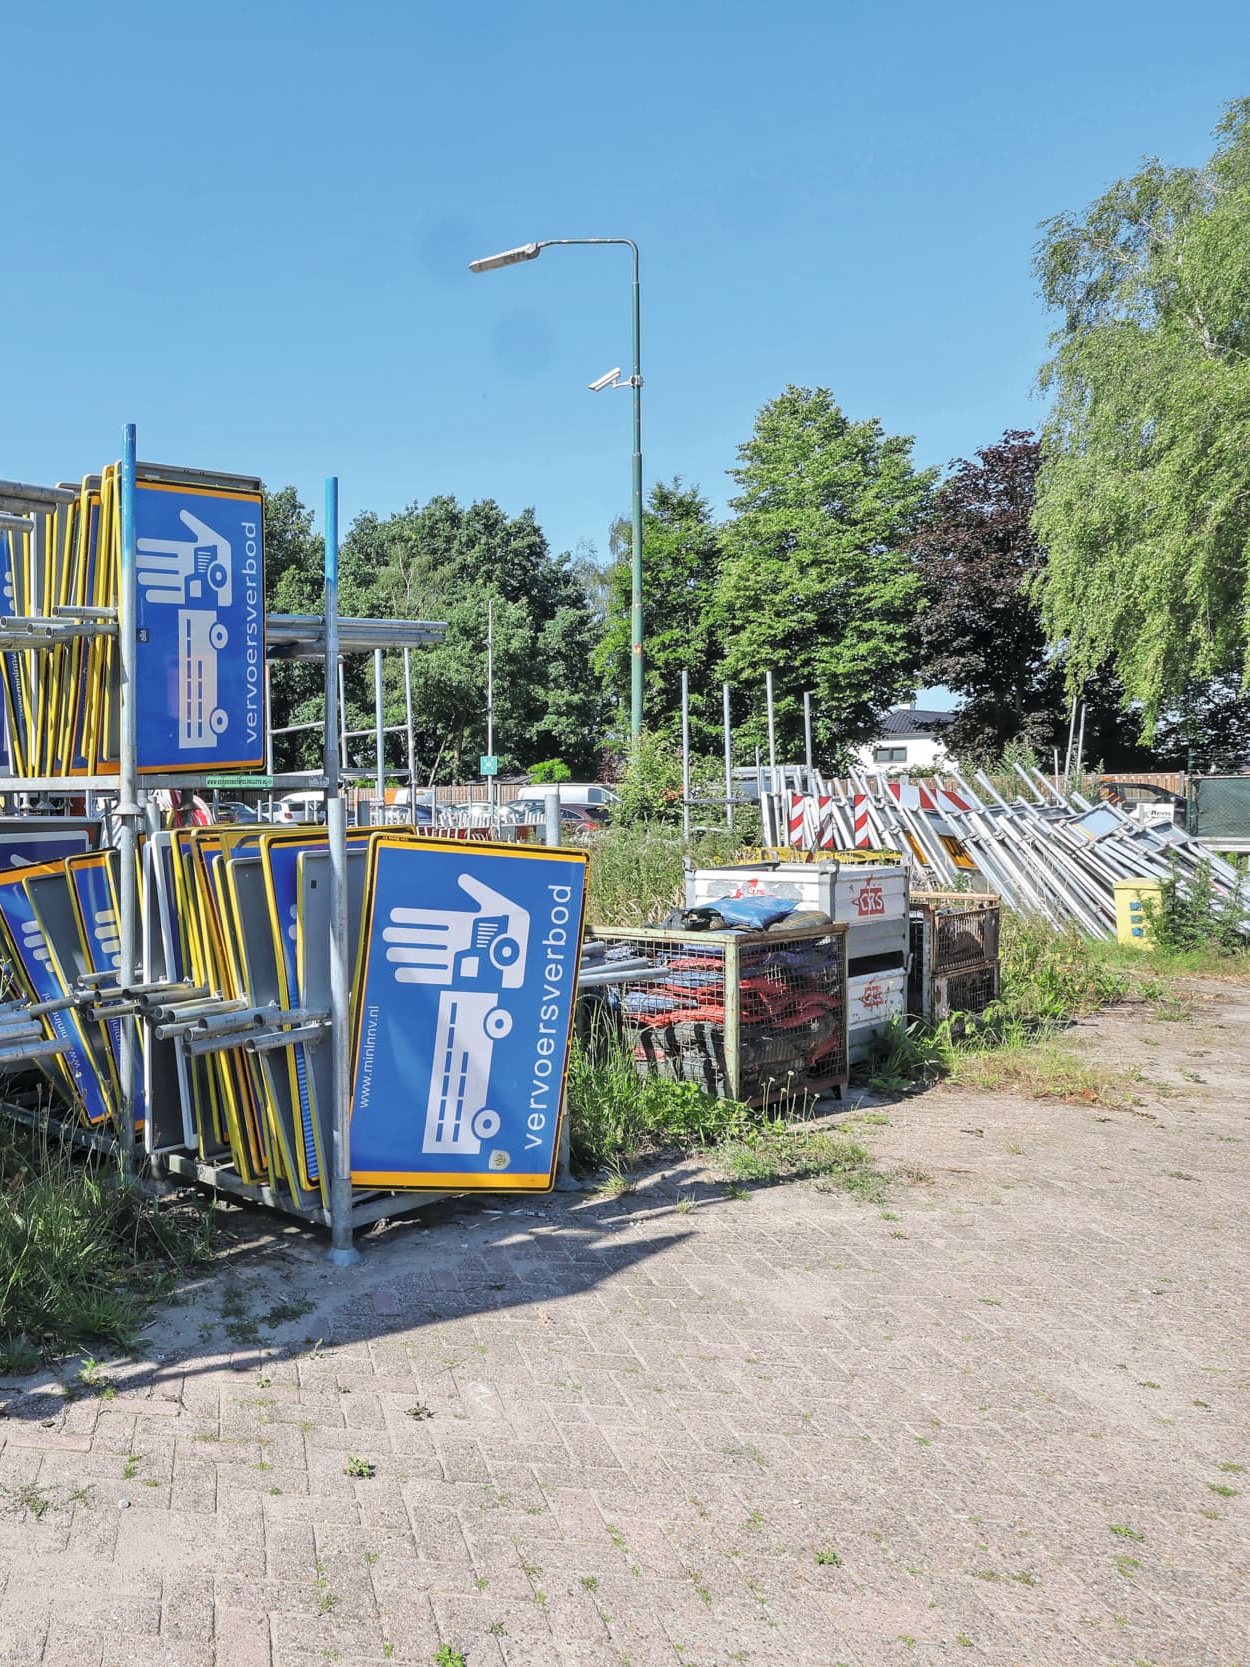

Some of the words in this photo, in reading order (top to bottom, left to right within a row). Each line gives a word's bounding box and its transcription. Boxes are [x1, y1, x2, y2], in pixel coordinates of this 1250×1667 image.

[241, 522, 258, 743] vervoersverbod
[860, 888, 883, 912] CRS
[524, 885, 572, 1150] vervoersverbod
